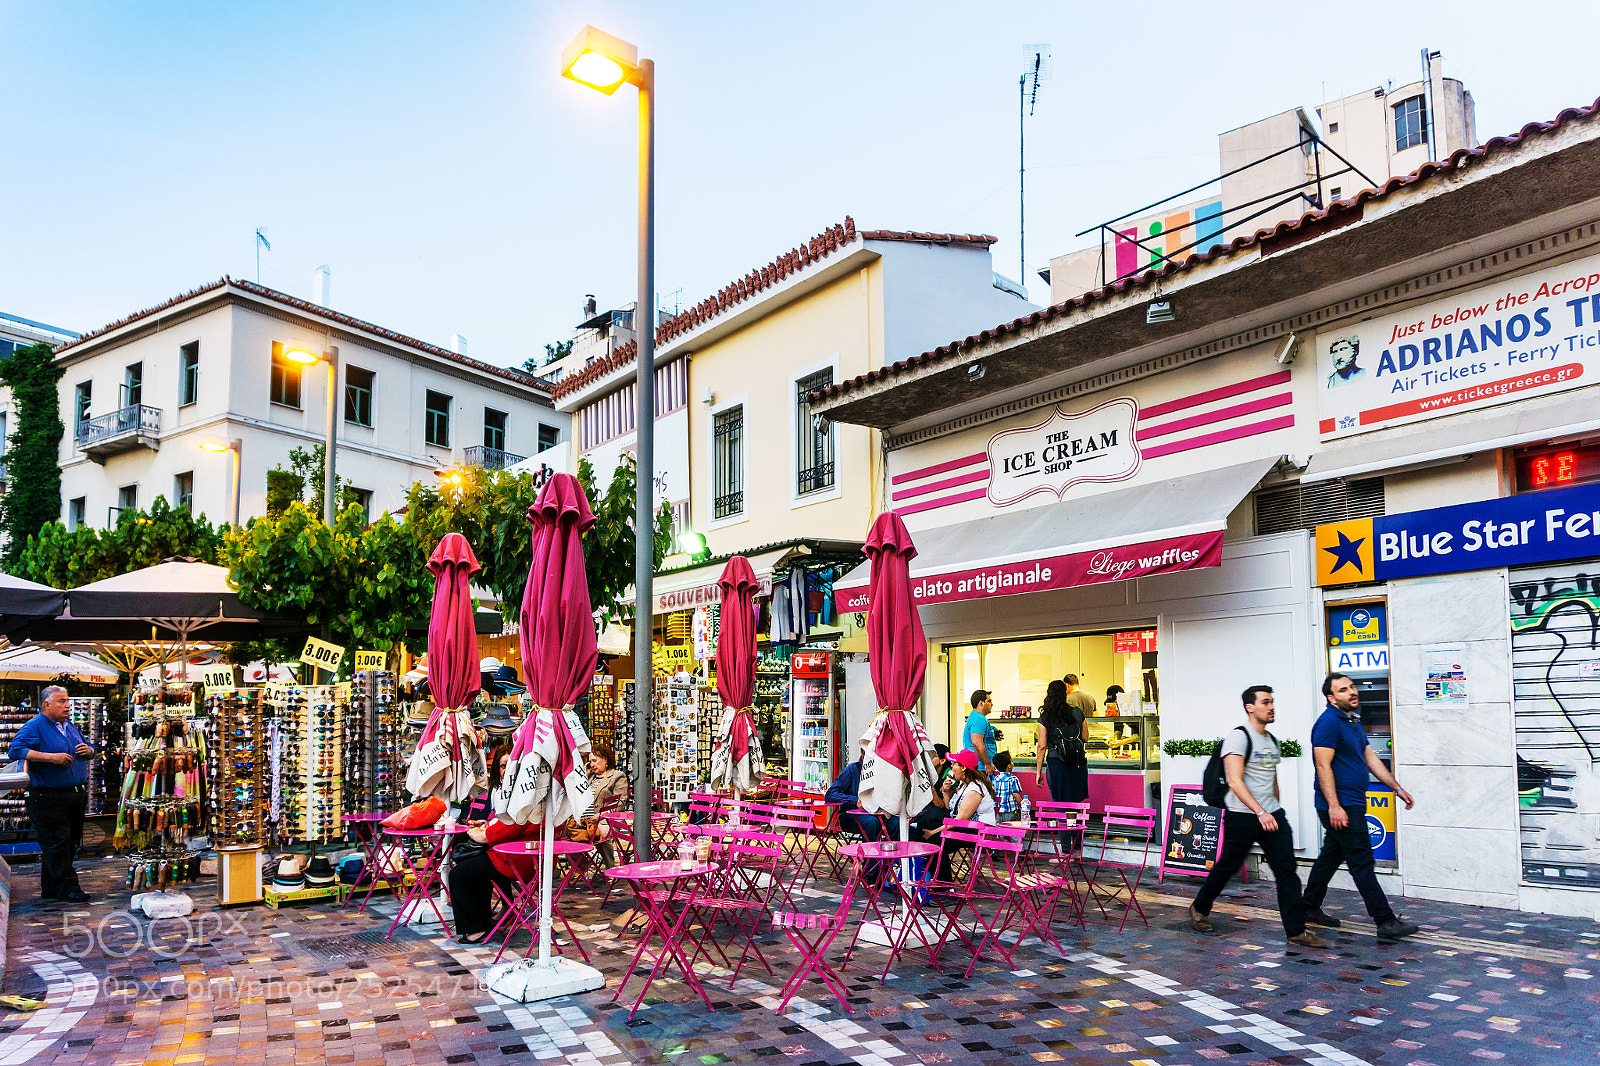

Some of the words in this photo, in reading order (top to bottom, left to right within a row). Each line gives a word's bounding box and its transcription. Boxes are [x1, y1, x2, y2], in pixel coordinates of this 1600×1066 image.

[1389, 320, 1425, 345] Just
[1431, 303, 1489, 330] below
[1495, 292, 1529, 311] the
[1376, 307, 1551, 377] ADRIANOS
[1391, 378, 1418, 394] Air
[1421, 359, 1487, 387] Tickets
[1507, 343, 1560, 366] Ferry
[1564, 329, 1600, 351] Tic
[1419, 367, 1574, 410] www.ticketgreece.gr
[1046, 430, 1069, 444] THE
[1003, 451, 1036, 474] ICE
[1042, 429, 1119, 463] CREAM
[1044, 460, 1073, 475] SHOP
[1380, 529, 1453, 562] Blue
[1462, 518, 1536, 552] Star
[913, 579, 952, 598] elato
[957, 563, 1052, 593] artigianale
[1087, 552, 1135, 580] Liege
[1138, 548, 1200, 569] waffles
[660, 585, 719, 611] SOUVENI
[305, 643, 339, 665] 3.00€
[357, 655, 382, 666] 3.00€
[666, 648, 689, 660] 1.00€
[1338, 650, 1388, 668] ATM
[204, 672, 232, 687] 3.00€
